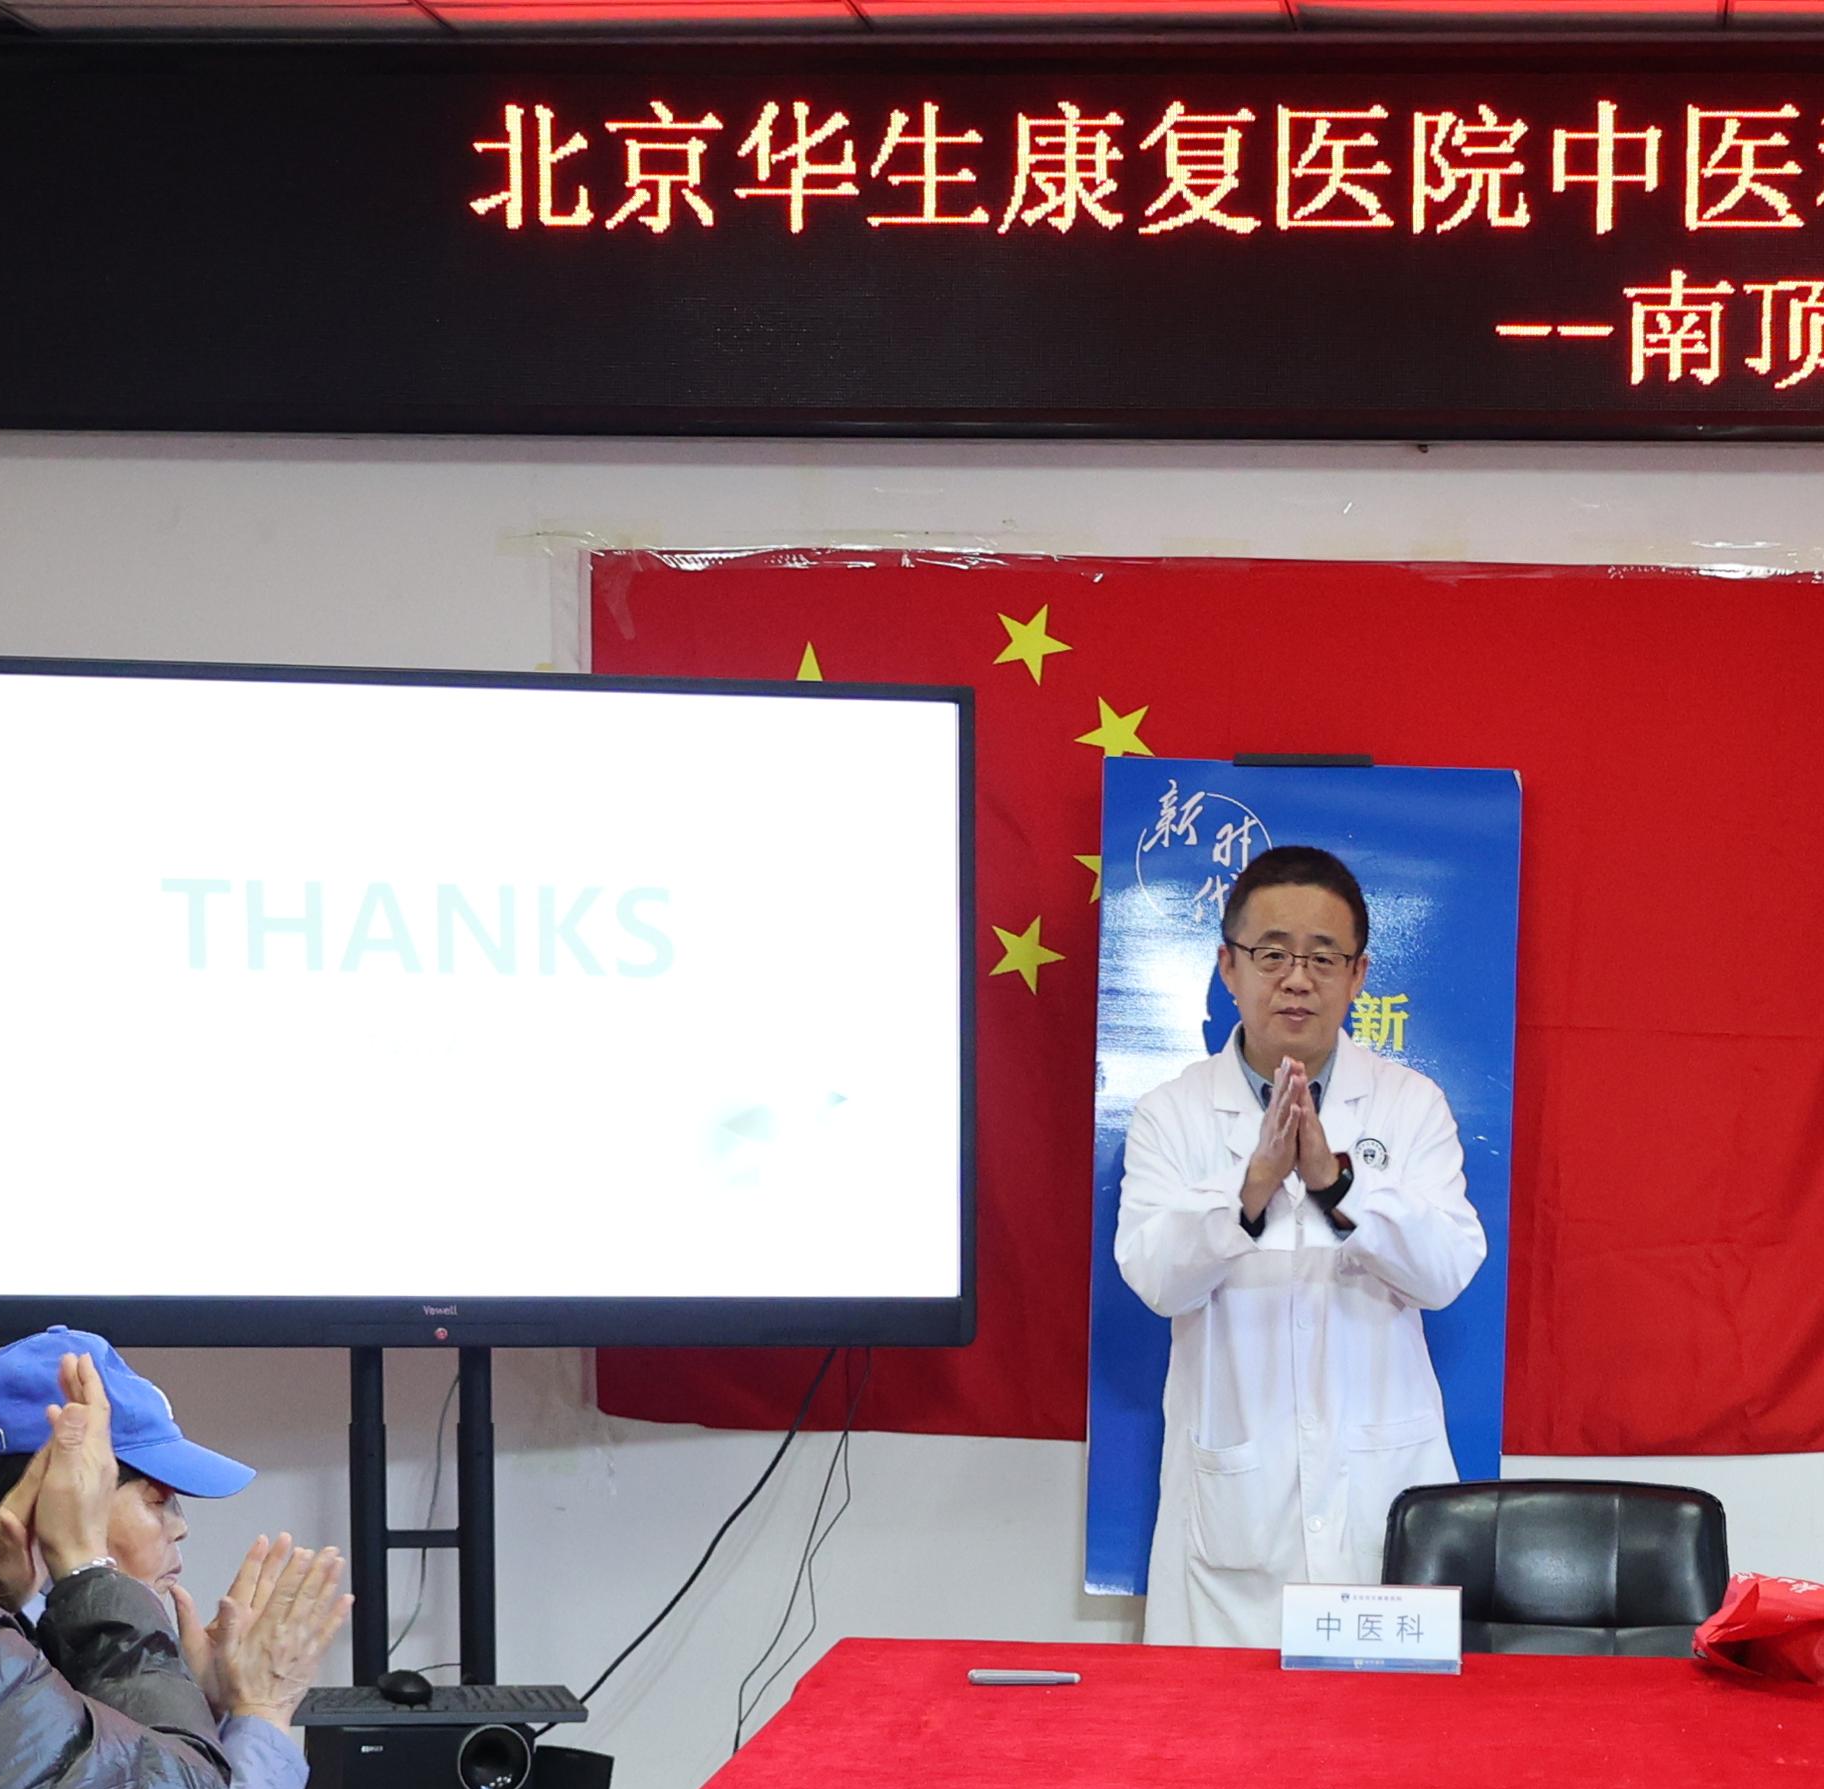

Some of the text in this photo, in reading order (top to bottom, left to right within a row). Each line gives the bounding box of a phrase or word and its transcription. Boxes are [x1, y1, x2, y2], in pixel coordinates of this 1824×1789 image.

[161, 878, 674, 978] THANKS
[1352, 992, 1410, 1053] 新
[1316, 1611, 1425, 1644] 中医科
